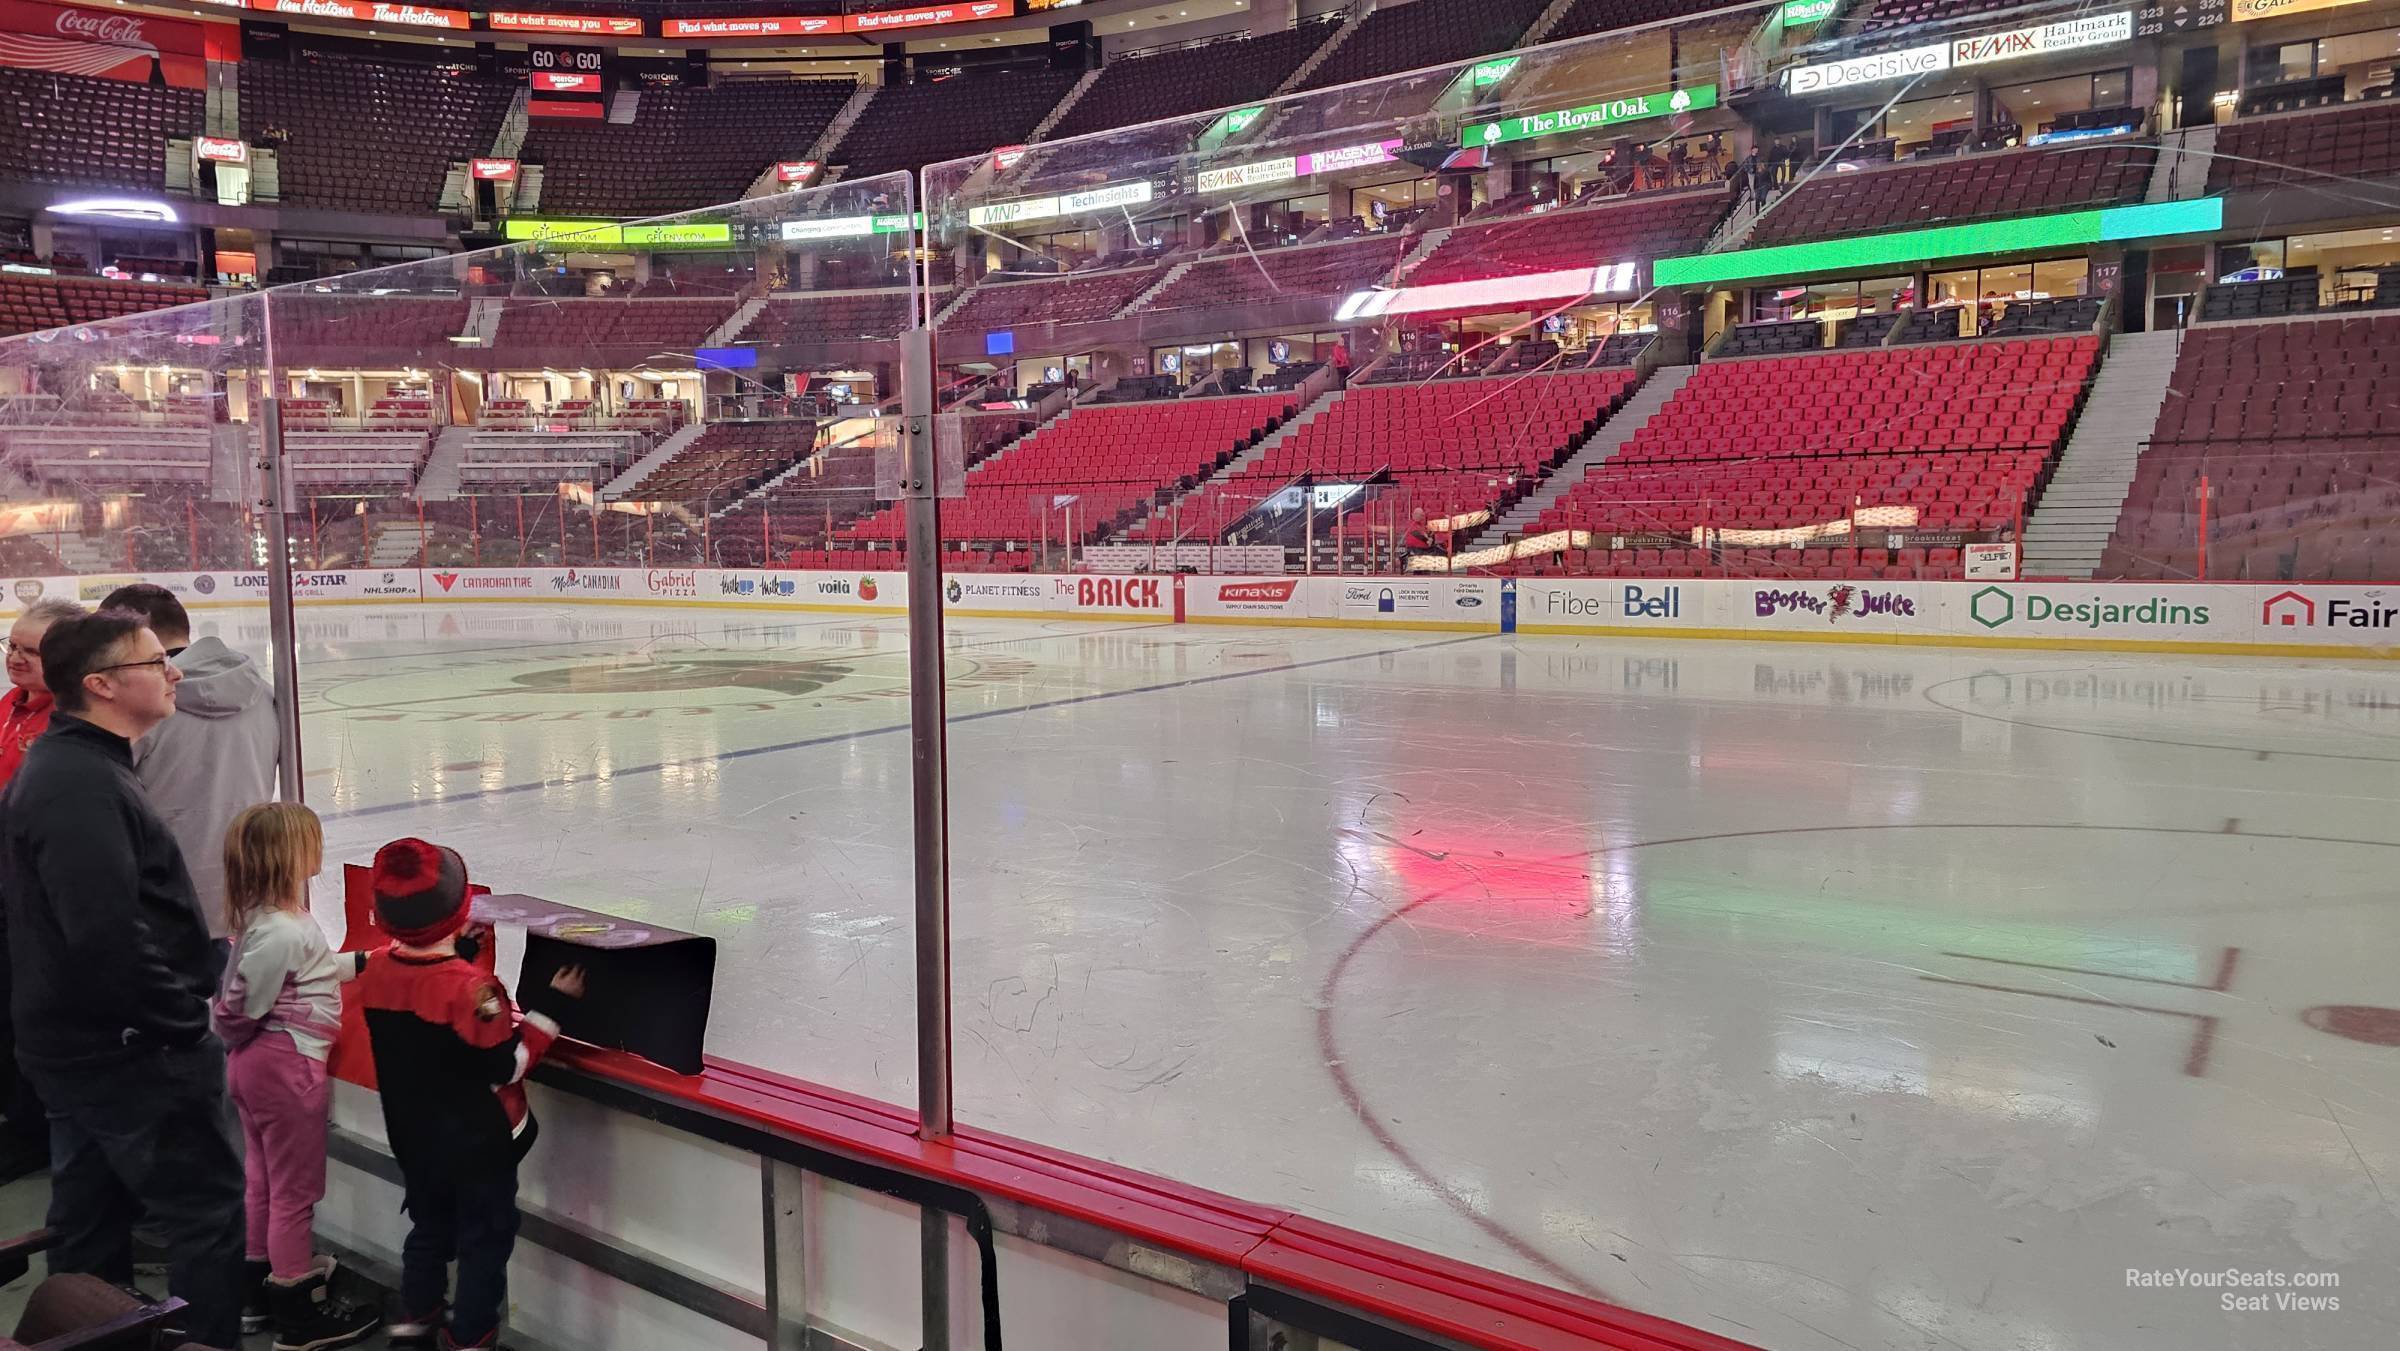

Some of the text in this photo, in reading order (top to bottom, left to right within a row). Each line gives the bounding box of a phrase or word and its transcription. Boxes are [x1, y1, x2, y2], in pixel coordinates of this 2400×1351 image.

[372, 3, 450, 27] Tim Hortons
[857, 9, 953, 26] Find what moves you
[2139, 7, 2165, 19] 323
[2198, 14, 2224, 27] 224
[494, 14, 600, 32] Find what moves you
[678, 20, 780, 33] Find what moves you
[2043, 15, 2128, 38] Hallmark
[2138, 24, 2163, 36] 223
[1957, 30, 2038, 63] RE/MAX
[2043, 28, 2128, 49] Realty Group
[533, 51, 554, 67] GO
[576, 52, 601, 70] GO!
[1825, 51, 1938, 87] Decisive
[1520, 97, 1650, 134] The Royal Oak
[1326, 144, 1384, 163] MAGENTA
[1247, 160, 1292, 174] Hallmark
[1183, 175, 1195, 184] 321
[1200, 169, 1245, 190] RE/MAX
[1070, 187, 1140, 208] TechInsights
[1183, 186, 1195, 194] 221
[983, 204, 1021, 223] MNP
[791, 224, 821, 234] Changing
[2096, 267, 2118, 277] 117
[1661, 307, 1679, 317] 116
[1401, 333, 1416, 342] 116
[233, 575, 268, 587] LONE
[311, 574, 346, 586] STAR
[463, 576, 533, 589] CANADIAN TIRE
[582, 575, 620, 590] CANADIAN
[648, 570, 696, 593] Gabriel
[818, 576, 850, 594] voilà
[662, 589, 697, 597] PIZZA
[965, 585, 1041, 597] PLANET FITNESS
[1054, 578, 1160, 608] The BRICK
[1346, 588, 1371, 600] Ford
[1548, 590, 1600, 616] Fibe
[1624, 585, 1679, 618] Bell
[1755, 589, 1915, 617] Booster Juice
[2026, 596, 2210, 628] Desjardins
[2328, 600, 2399, 628] Fair
